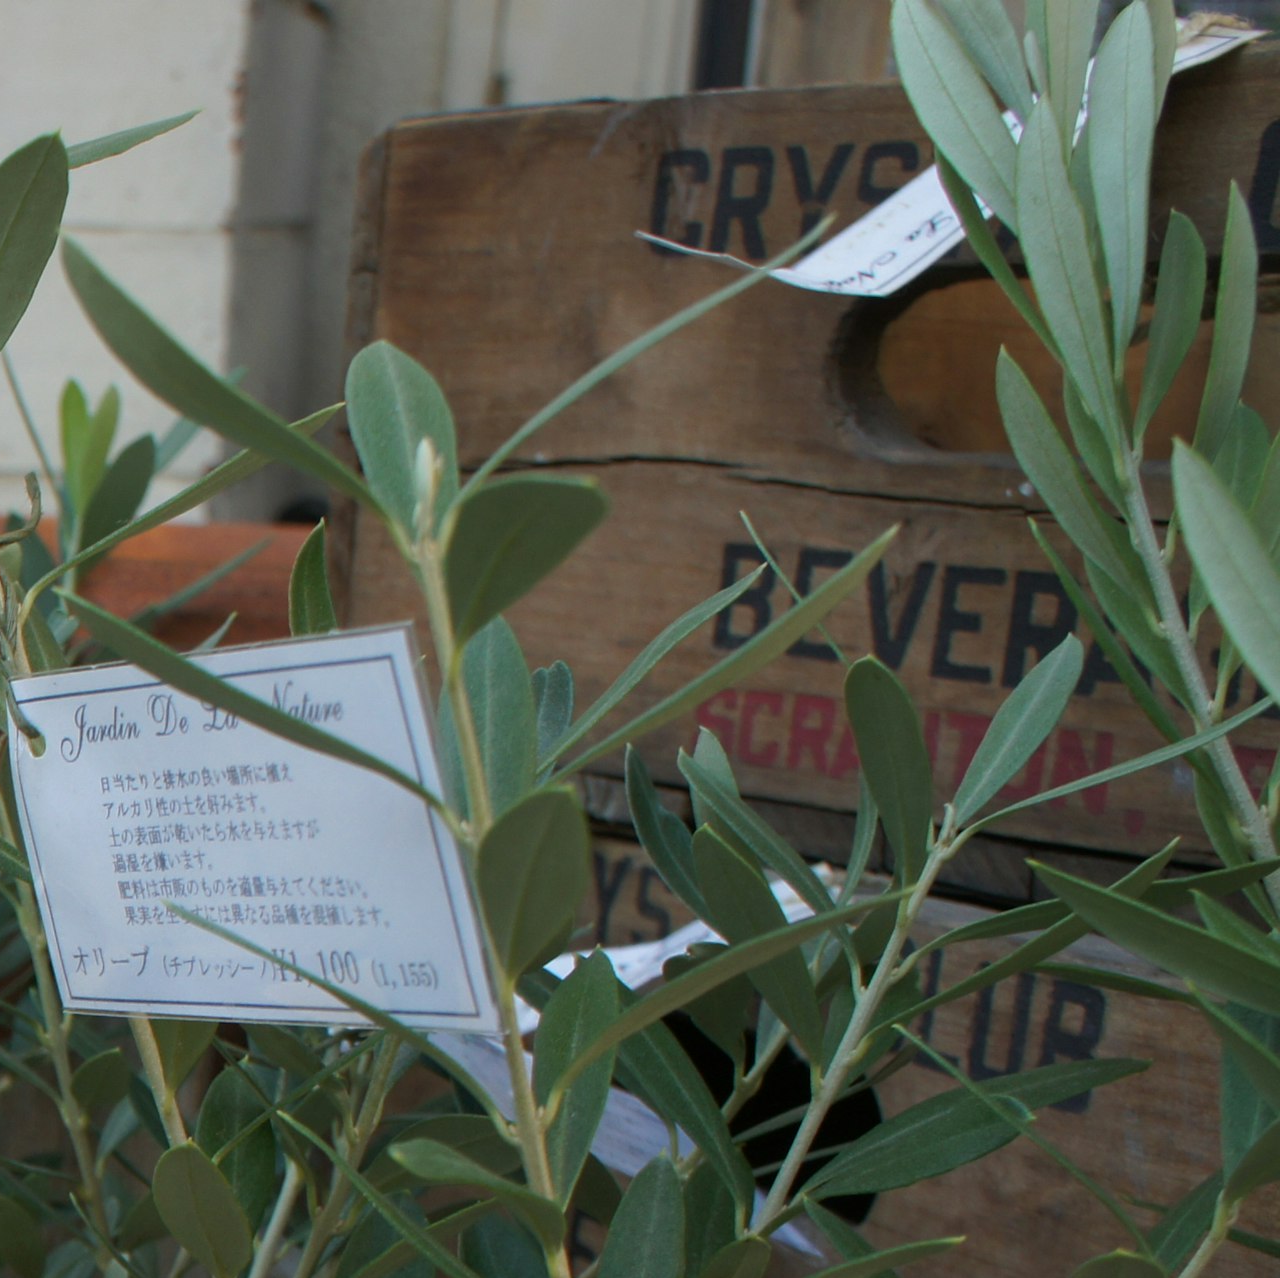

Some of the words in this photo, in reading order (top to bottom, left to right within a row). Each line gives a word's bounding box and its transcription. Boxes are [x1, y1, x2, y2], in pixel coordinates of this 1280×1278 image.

[60, 702, 141, 763] Jardin
[146, 693, 190, 737] De
[102, 792, 266, 820] アルカリ性の土を好みます。
[108, 818, 320, 848] 土の表面が乾いたら水を与えますが
[72, 944, 150, 977] オリーブ
[371, 959, 439, 990] (1,155)
